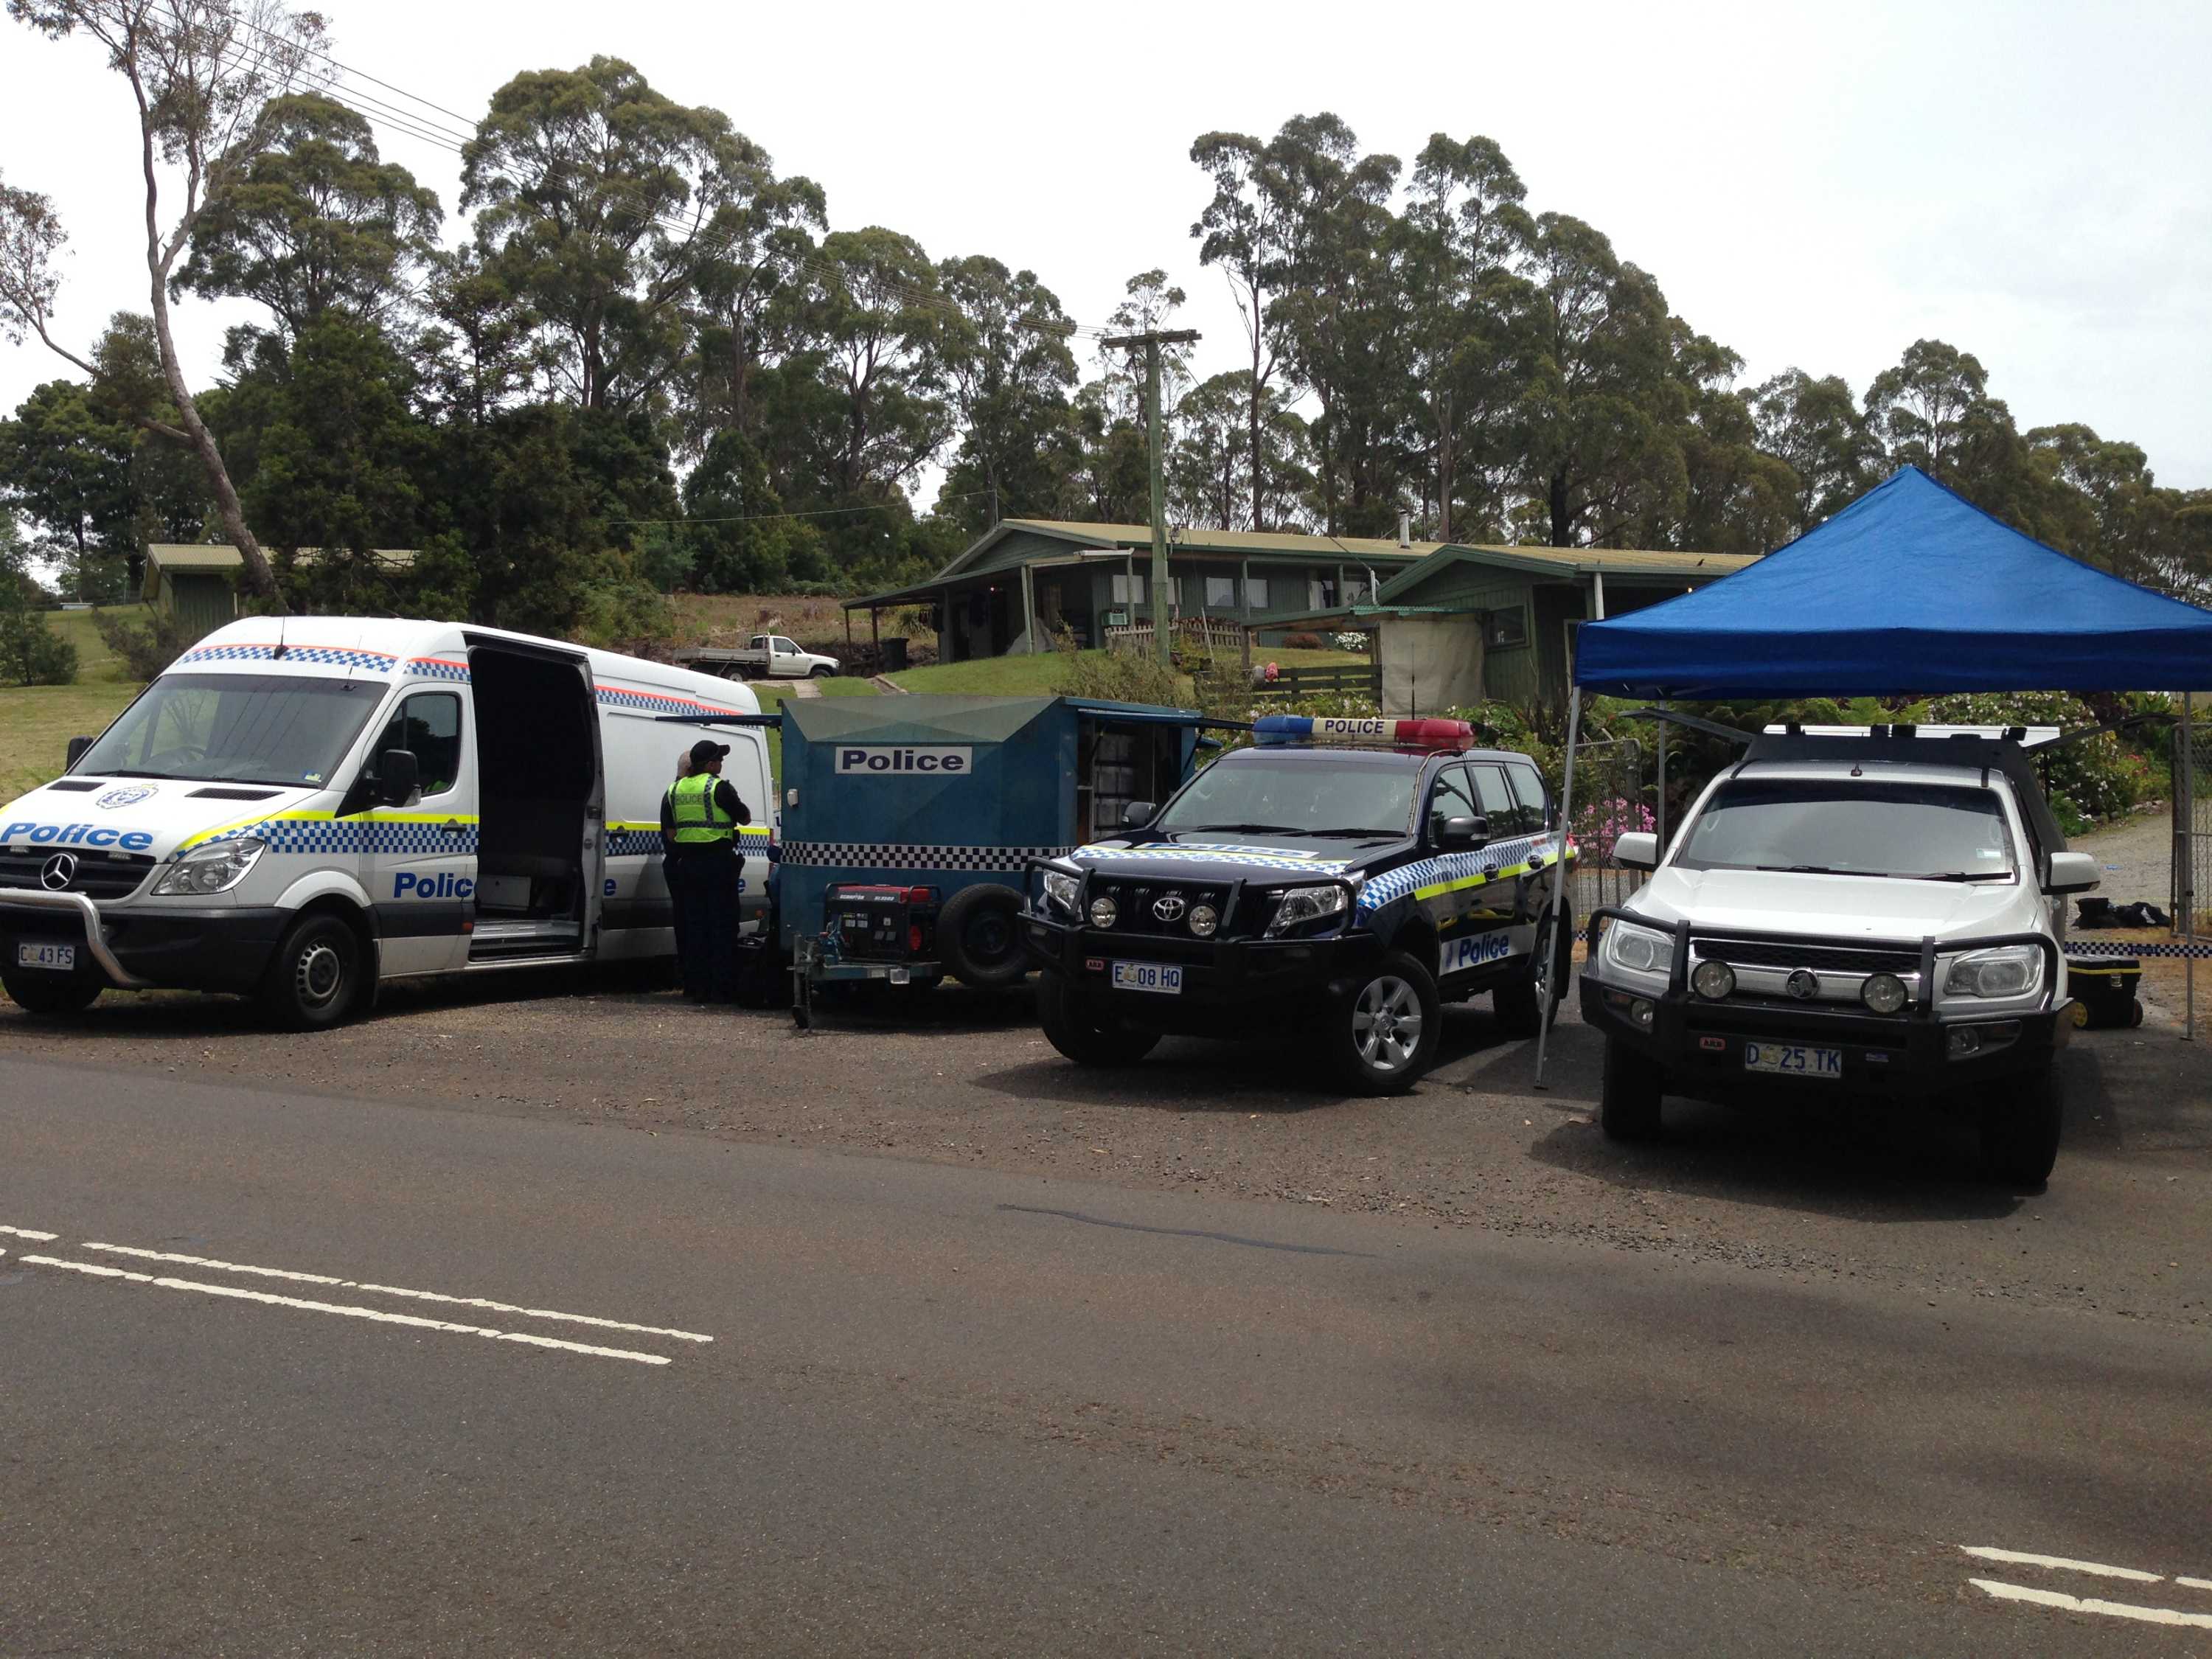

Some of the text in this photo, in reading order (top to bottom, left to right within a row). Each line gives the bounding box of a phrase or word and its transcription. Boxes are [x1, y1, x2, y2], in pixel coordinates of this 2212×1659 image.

[1325, 720, 1384, 734] POLICE
[842, 750, 964, 771] Police
[0, 823, 153, 850] Police
[1146, 844, 1304, 855] Police
[394, 873, 478, 898] Polic
[1458, 933, 1509, 967] Police
